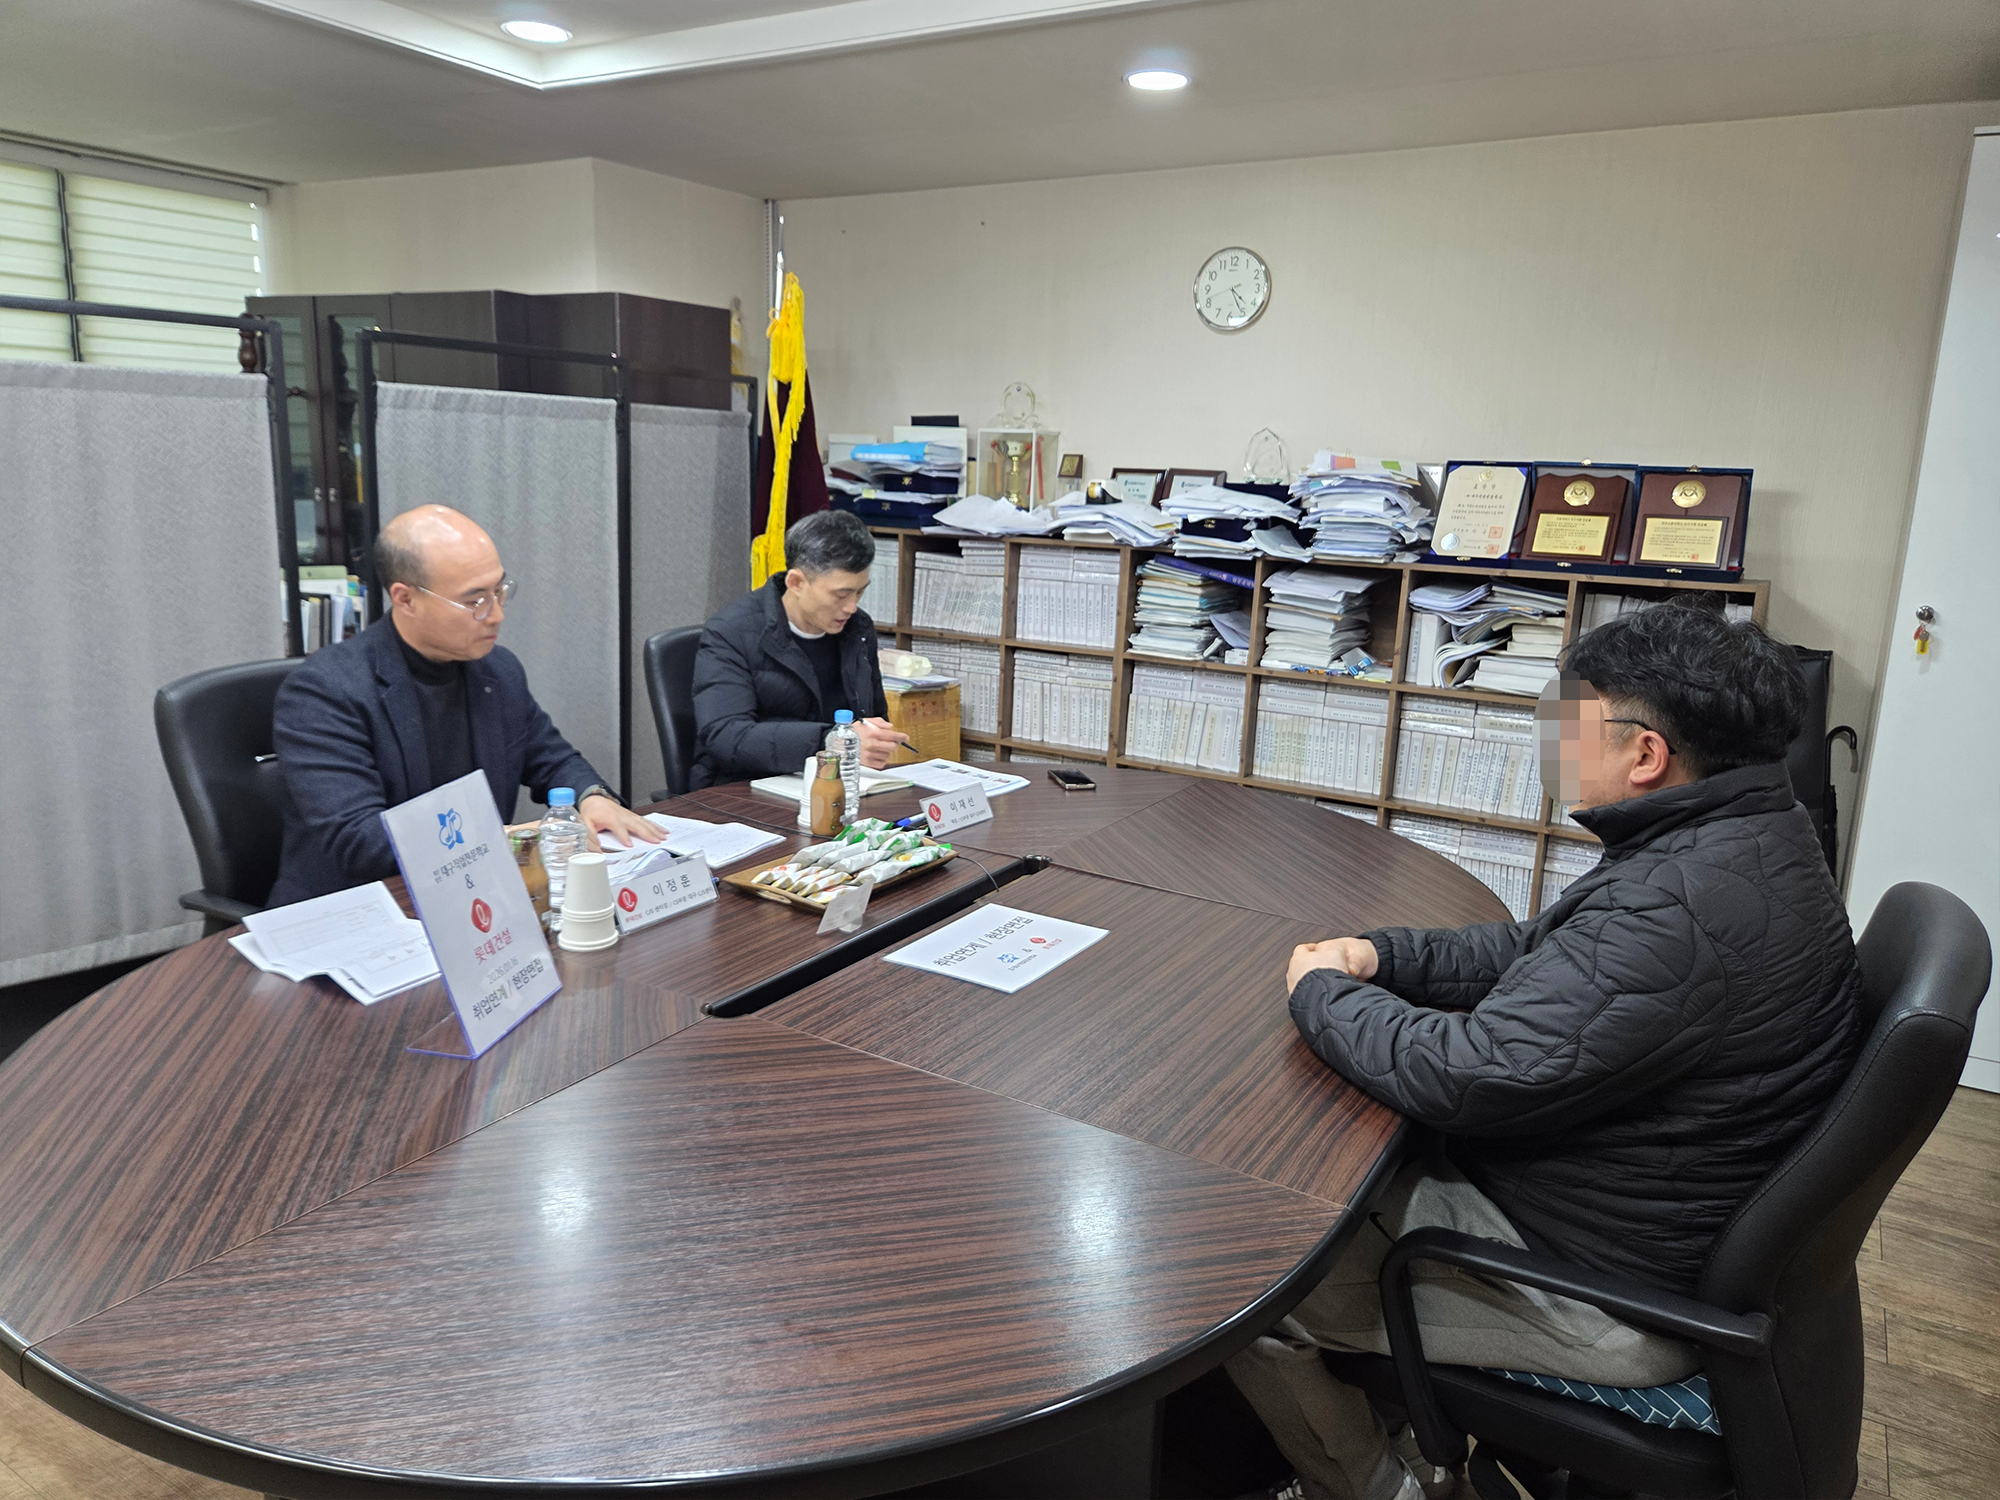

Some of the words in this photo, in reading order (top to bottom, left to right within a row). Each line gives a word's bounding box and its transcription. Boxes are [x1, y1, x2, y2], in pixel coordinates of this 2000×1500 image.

[1218, 259, 1227, 270] 11
[1230, 255, 1240, 267] 12
[1208, 270, 1218, 281] 10
[1253, 268, 1260, 280] 2
[1204, 284, 1211, 295] 9
[1254, 283, 1261, 294] 3
[1205, 297, 1212, 308] 8
[1250, 297, 1257, 307] 4
[1215, 307, 1222, 318] 7
[1239, 307, 1246, 317] 5
[464, 873, 476, 889] &
[474, 927, 513, 965] 롯데건설
[932, 941, 988, 967] 취업연계
[984, 915, 1034, 940] 현장면접
[472, 983, 509, 1021] 취업연계
[512, 958, 545, 990] 현장면접
